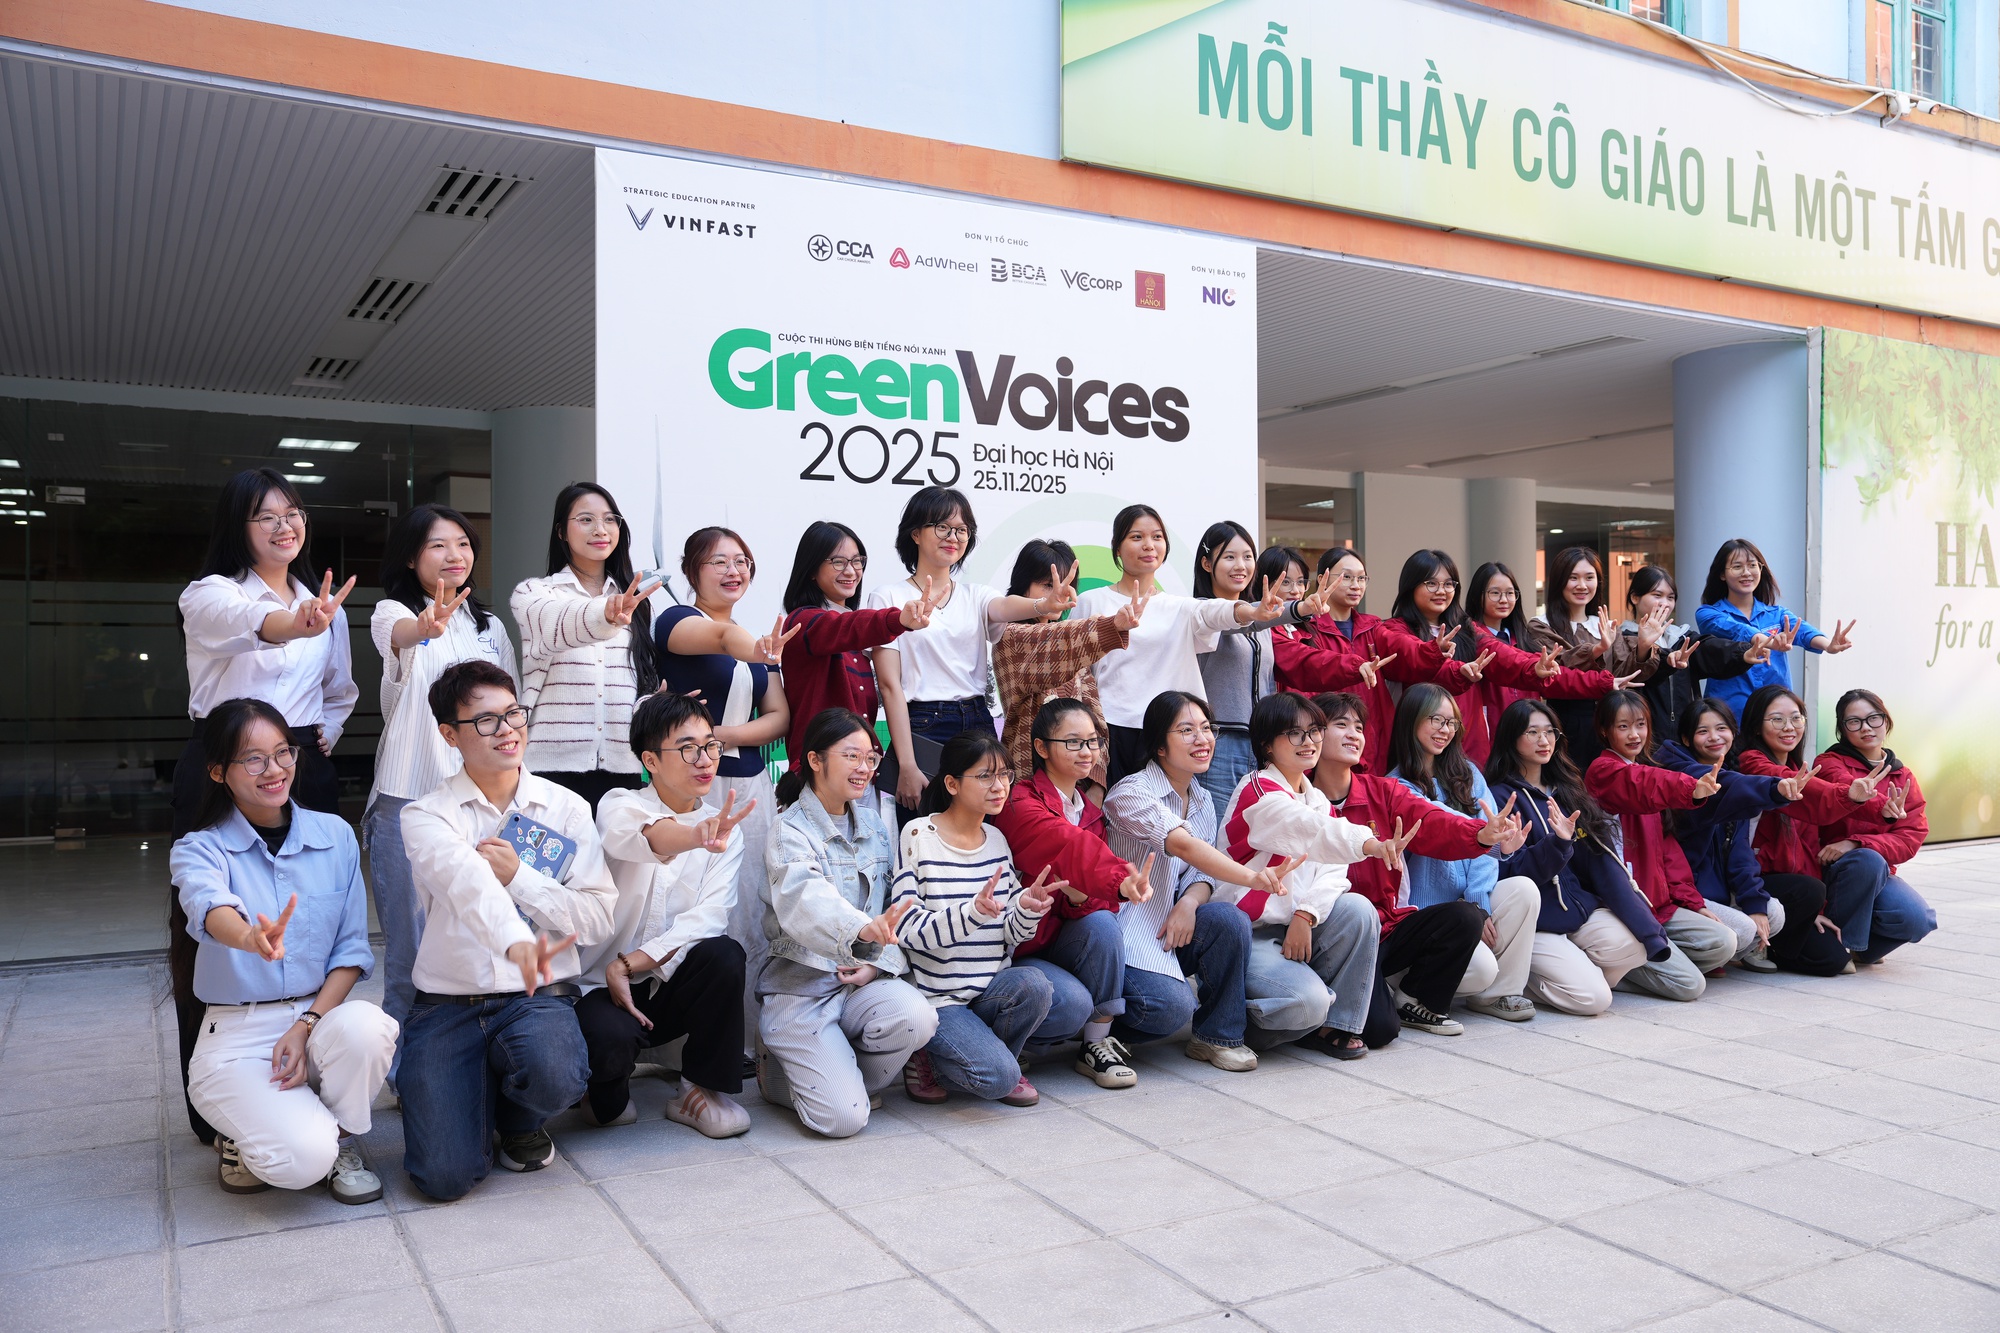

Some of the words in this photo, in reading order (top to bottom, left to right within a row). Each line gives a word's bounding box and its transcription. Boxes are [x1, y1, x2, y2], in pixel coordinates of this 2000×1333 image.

[1198, 21, 1313, 137] MỖI
[1339, 58, 1488, 170] THẦY
[1512, 102, 1577, 189] CÔ
[1600, 127, 1705, 216] GIÁO
[1726, 150, 1776, 232] LÀ
[1794, 170, 1876, 259] MỘT
[1890, 180, 1966, 270] TẤM
[623, 186, 669, 199] STRATEGIC
[671, 193, 718, 205] EDUCATION
[720, 200, 756, 210] PARTNER
[663, 214, 757, 239] VINFAST
[964, 232, 982, 240] ĐƠN
[984, 235, 992, 243] VỊ
[836, 240, 874, 259] CCA
[914, 254, 978, 273] AdWheel
[1011, 262, 1047, 282] BCA
[1202, 286, 1236, 307] NIC
[778, 332, 806, 345] CUỘC
[808, 335, 823, 344] THI
[825, 336, 852, 348] HÙNG
[854, 339, 874, 350] BIỆN
[876, 340, 902, 352] TIẾNG
[904, 343, 920, 354] NÓI
[922, 346, 947, 356] XANH
[800, 421, 961, 488] 2025
[973, 443, 1006, 469] Đại
[1011, 445, 1048, 471] học
[1053, 448, 1079, 469] Hà
[1084, 451, 1114, 476] Nội
[973, 469, 1067, 495] 25.11.2025
[1934, 521, 2000, 588] HA
[1926, 603, 1973, 668] for
[1978, 620, 1994, 649] a
